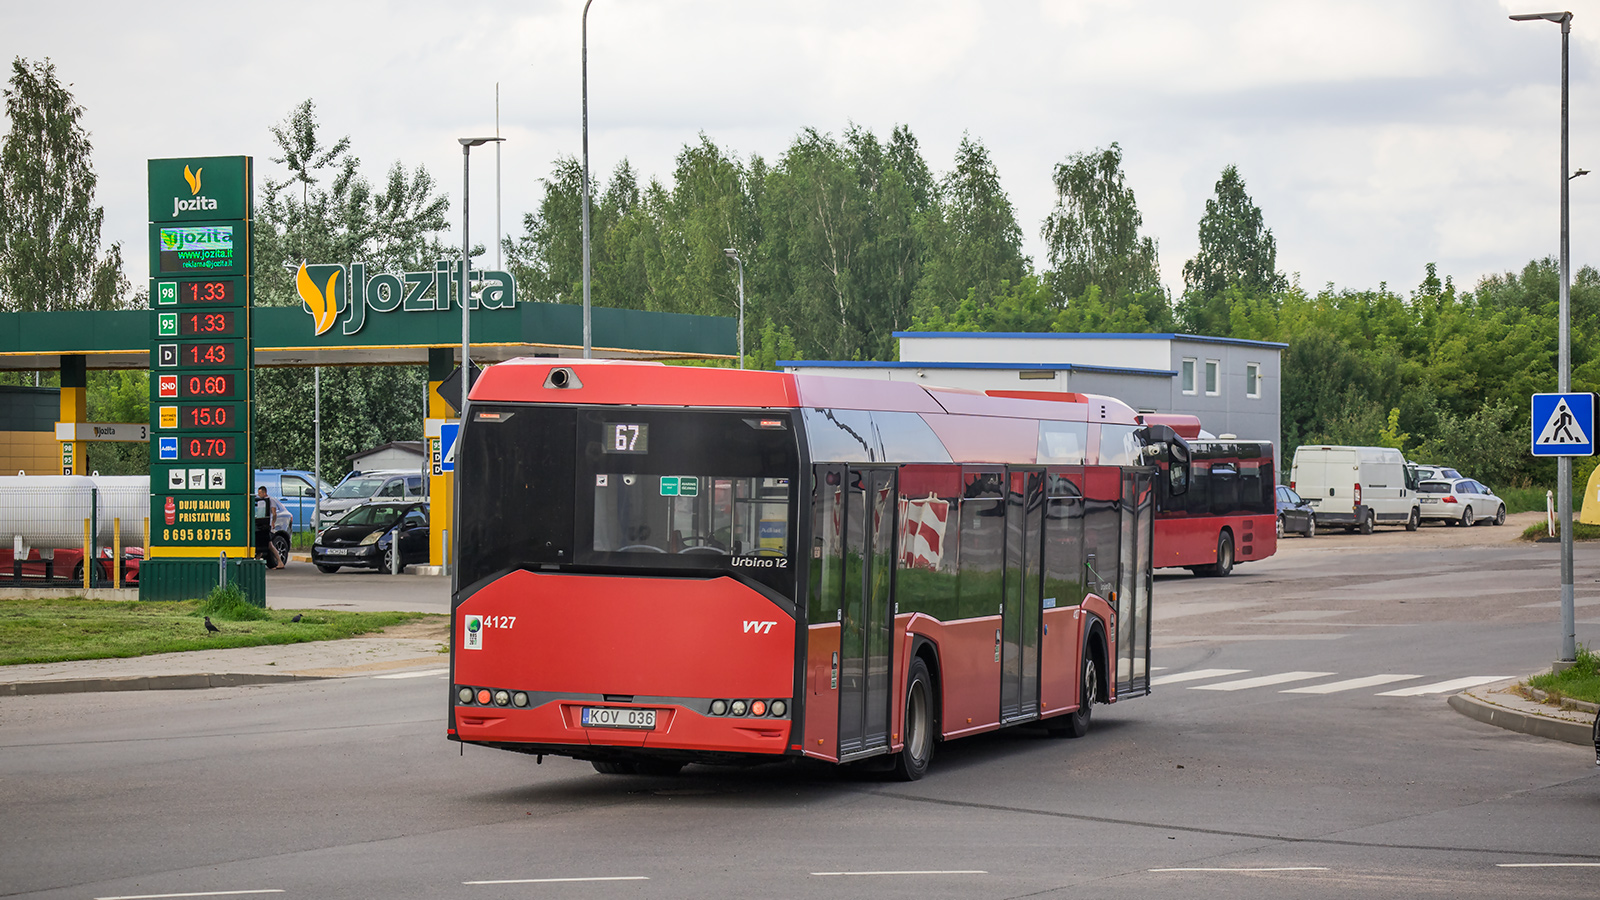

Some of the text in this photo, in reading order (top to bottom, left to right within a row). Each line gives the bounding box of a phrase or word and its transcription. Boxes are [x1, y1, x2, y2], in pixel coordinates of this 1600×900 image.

[178, 248, 233, 260] www.jozita.lt
[162, 282, 226, 300] 98 1.33
[162, 314, 226, 332] 95 1.33
[164, 346, 226, 363] D 1.43
[161, 376, 226, 394] SND 0.60
[191, 408, 226, 426] 15.0
[140, 426, 146, 439] 3
[616, 424, 639, 451] 67
[190, 439, 226, 456] 0.70
[179, 500, 230, 511] DUJŲ BALIONŲ
[179, 512, 230, 522] PRISTATYMAS
[163, 529, 231, 540] 8 695 88755
[731, 557, 788, 568] Urbino 12
[483, 615, 516, 629] 4127
[743, 621, 778, 634] VVT
[590, 710, 619, 723] KOV
[628, 712, 653, 724] 036
